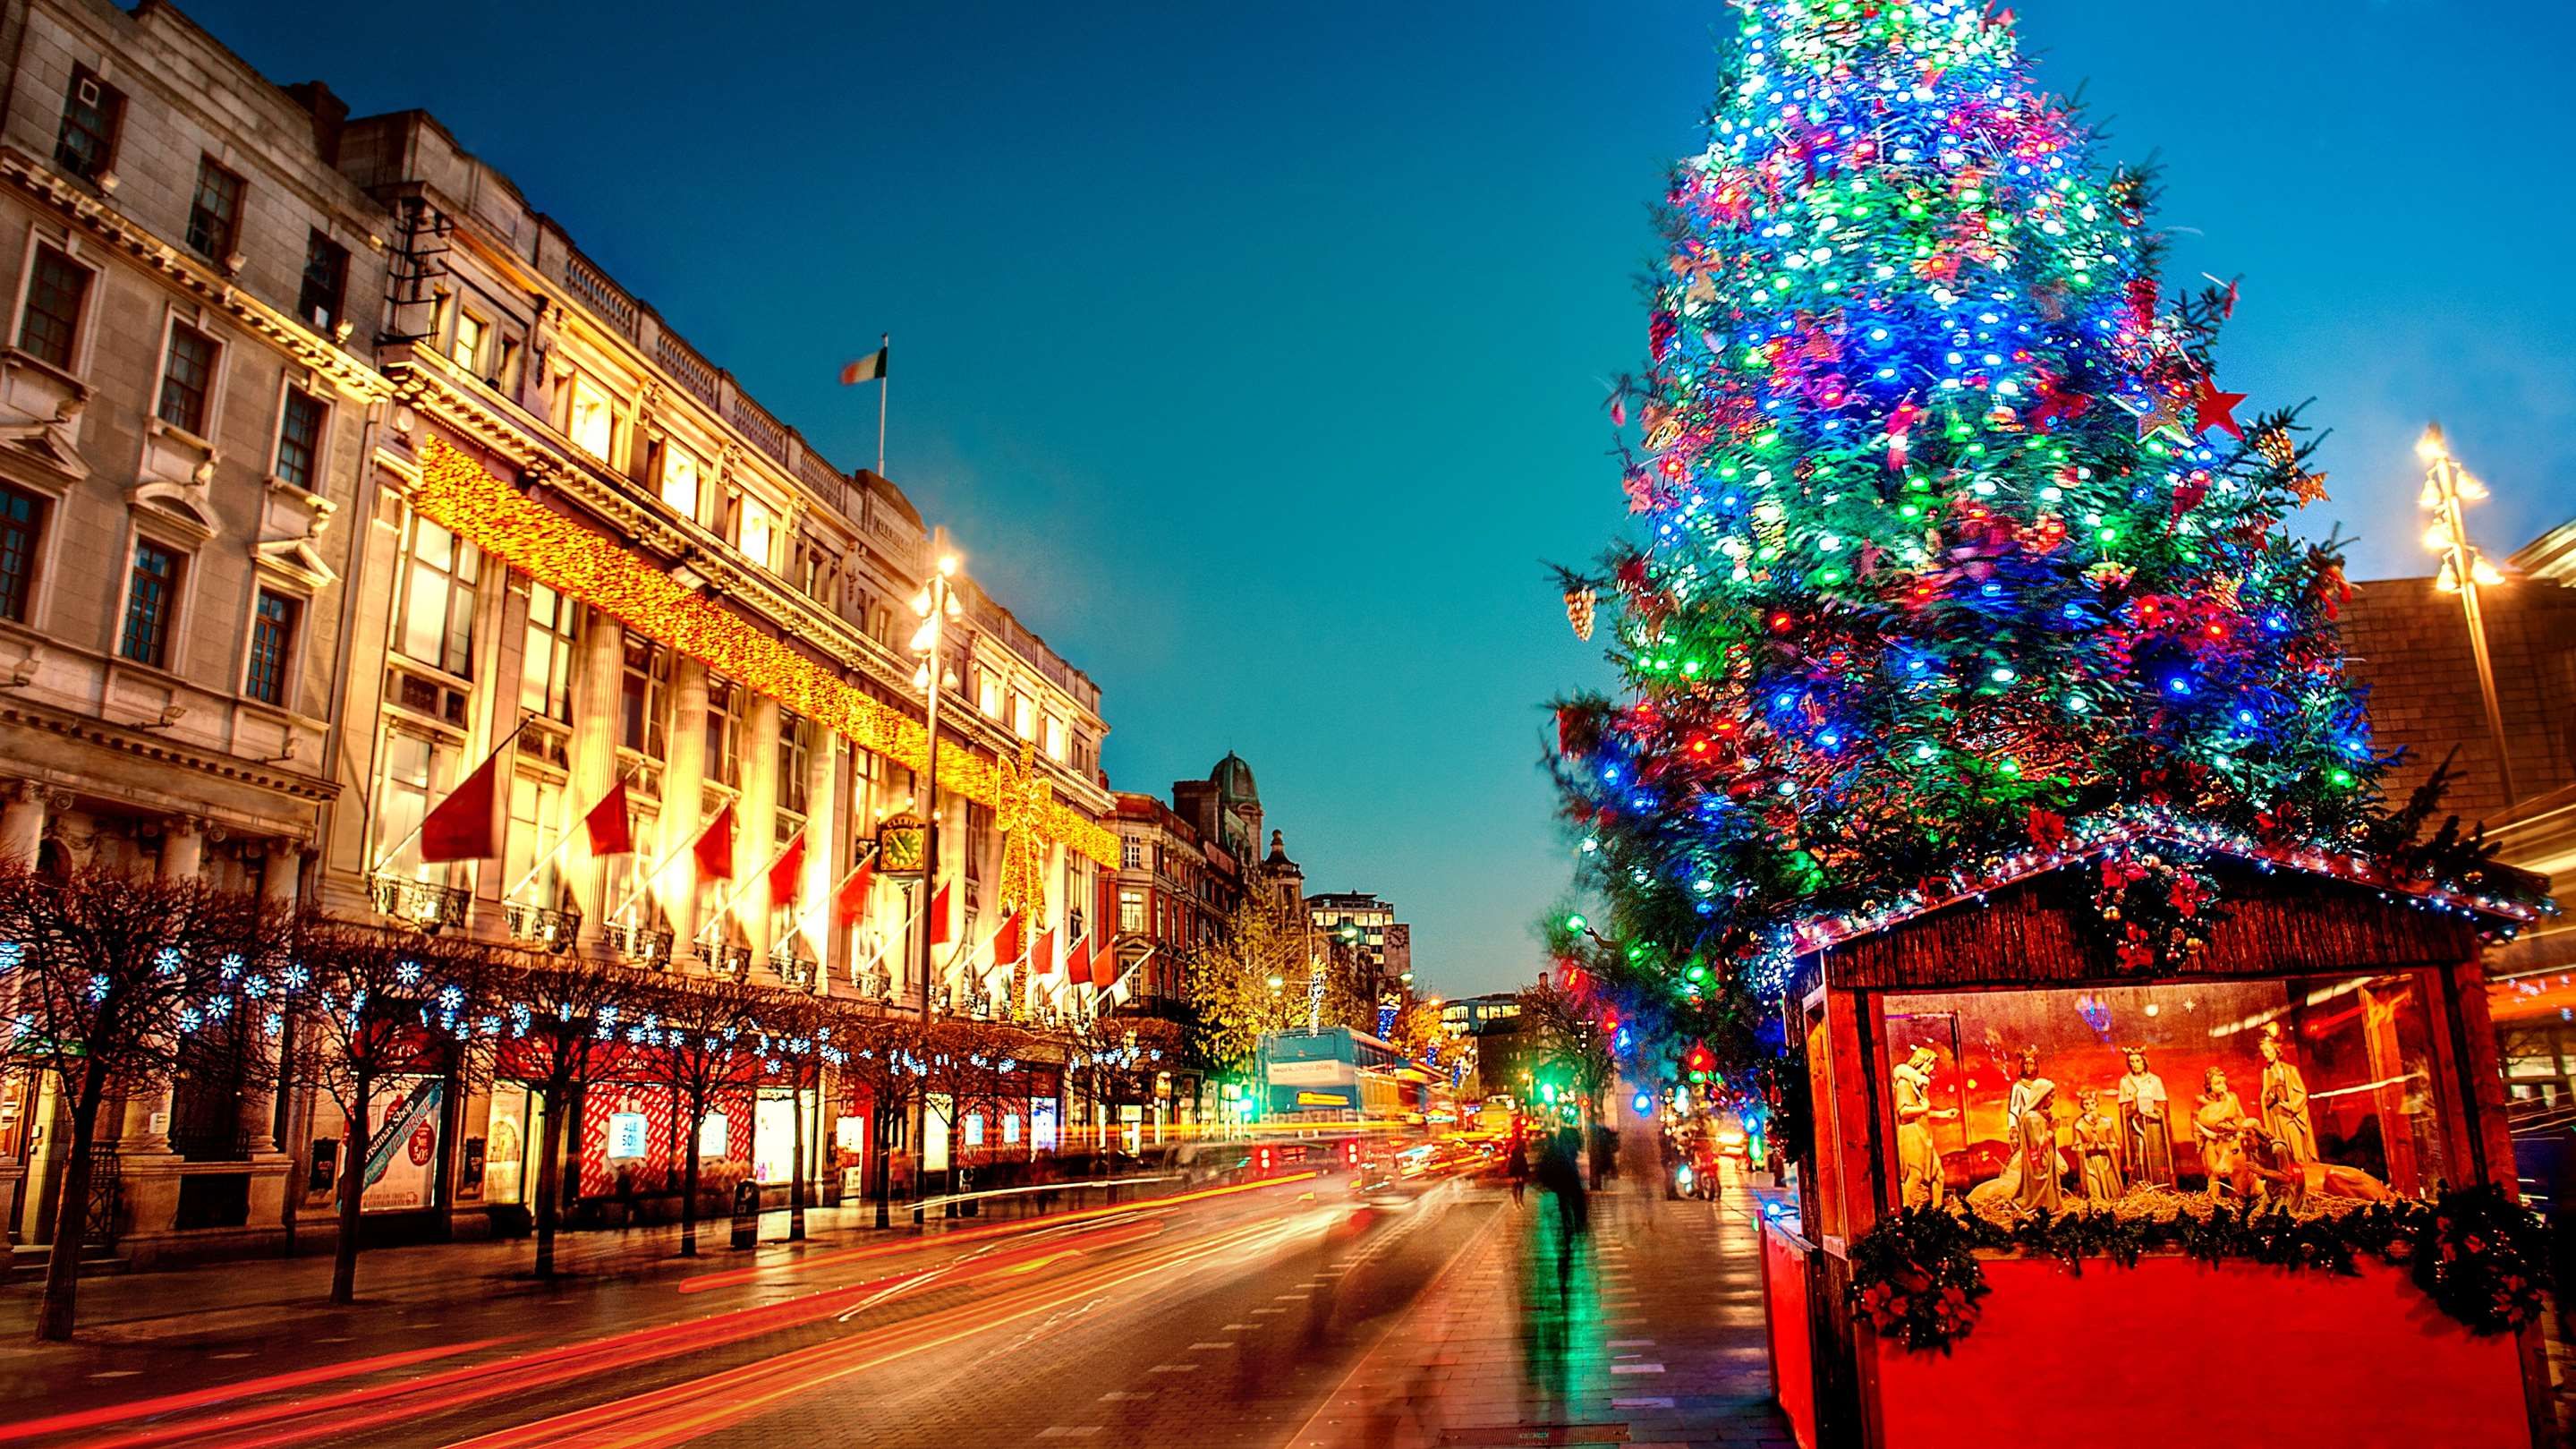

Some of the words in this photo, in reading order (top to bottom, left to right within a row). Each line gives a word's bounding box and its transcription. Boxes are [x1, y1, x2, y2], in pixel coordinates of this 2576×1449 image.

[365, 1124, 394, 1163] ristmas
[392, 1100, 414, 1127] Shop
[402, 1100, 431, 1139] PRICE
